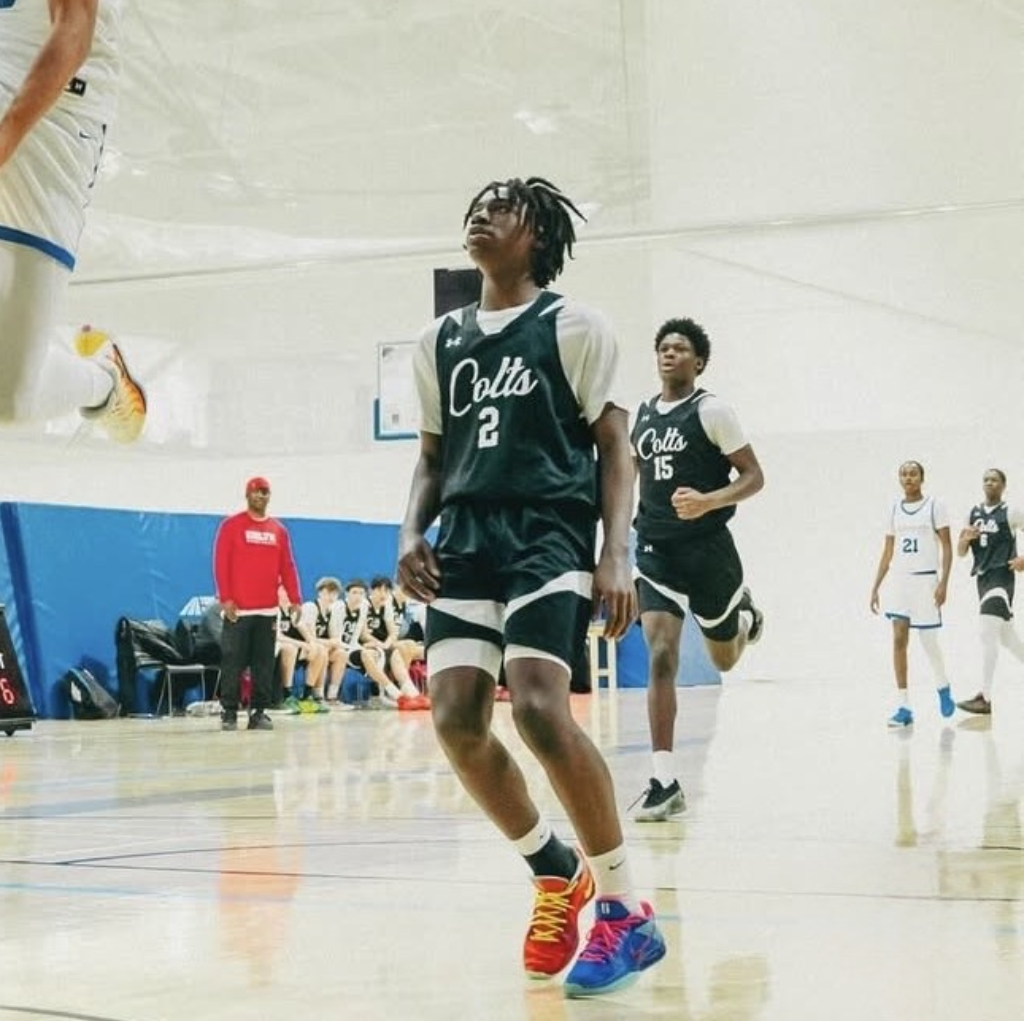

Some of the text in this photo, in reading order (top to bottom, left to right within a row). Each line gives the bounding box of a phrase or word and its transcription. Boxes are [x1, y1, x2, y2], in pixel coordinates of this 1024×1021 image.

[448, 356, 539, 417] Colts
[477, 406, 500, 449] 2
[637, 427, 688, 461] Colts
[653, 455, 674, 481] 15
[902, 538, 918, 554] 21
[0, 678, 15, 704] 6
